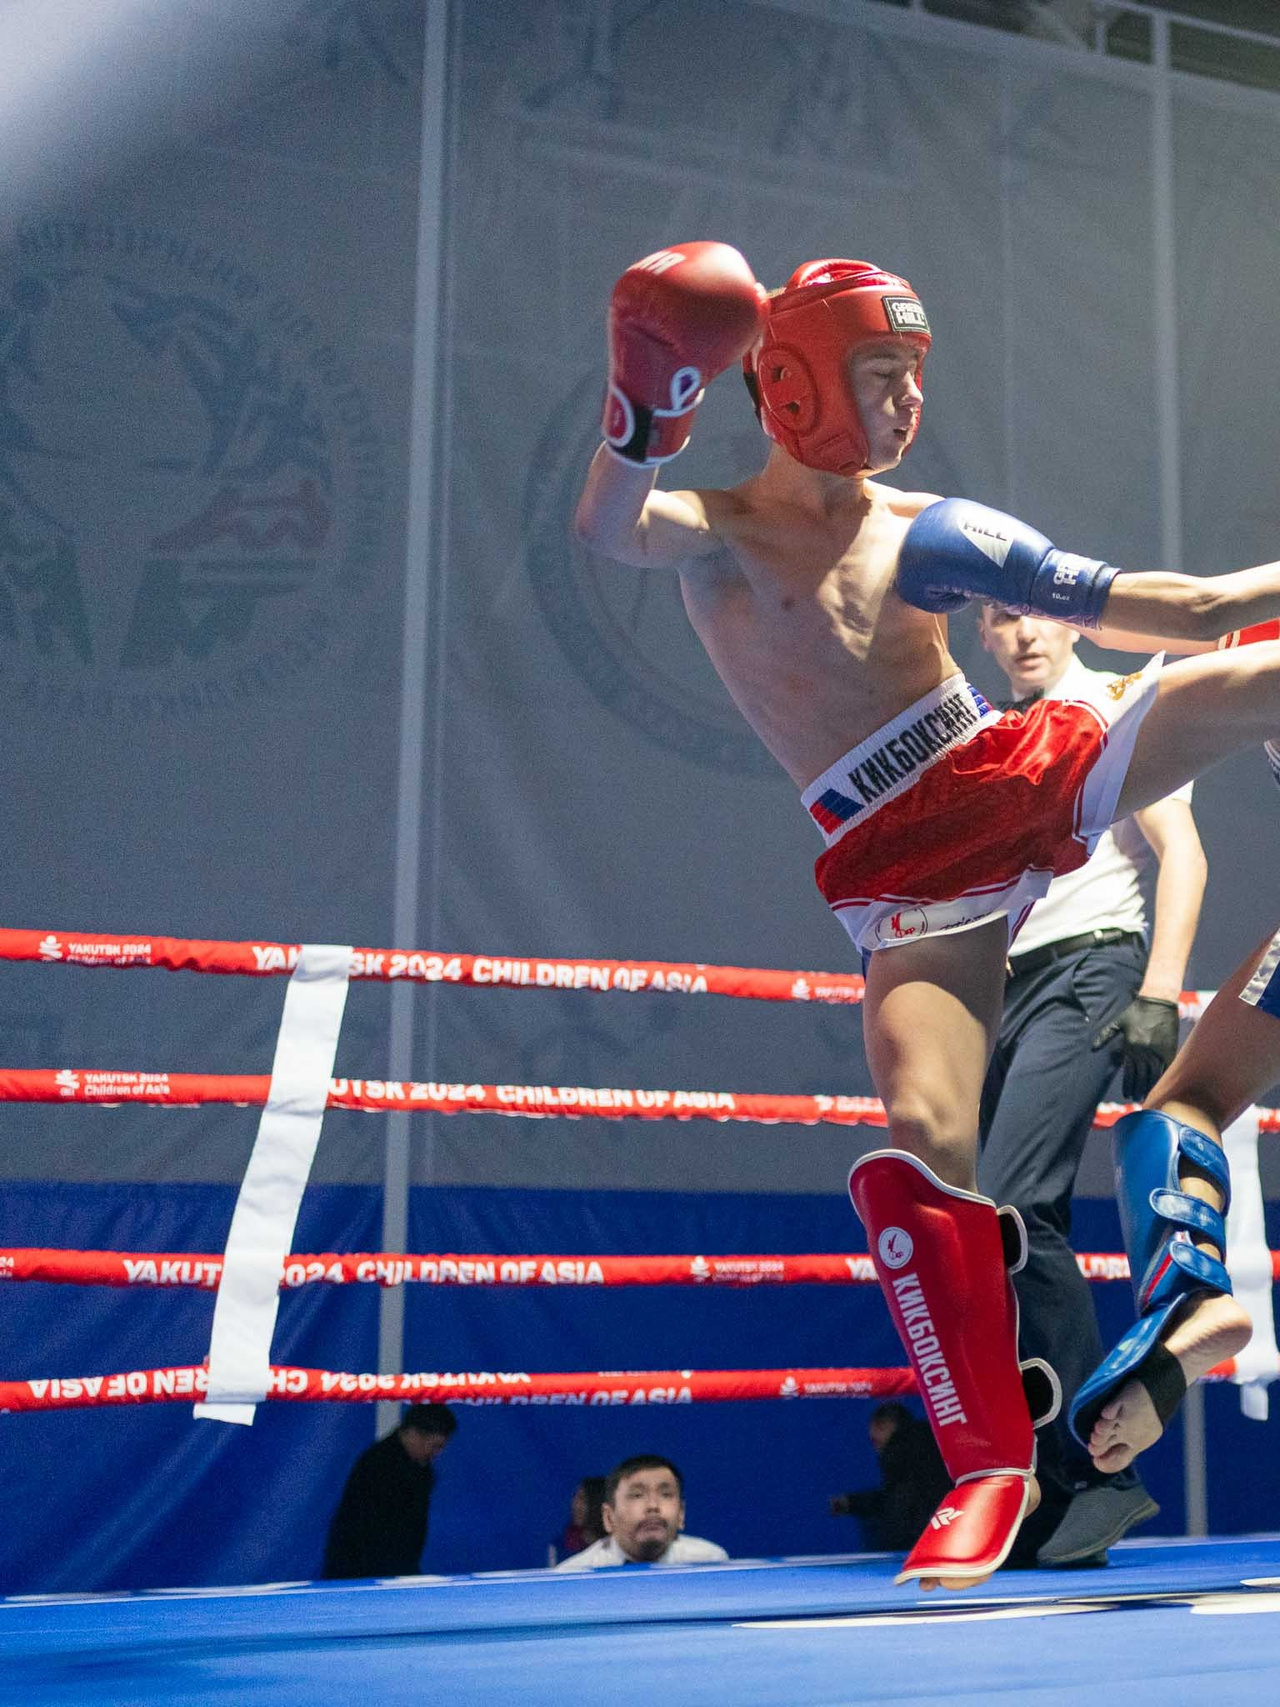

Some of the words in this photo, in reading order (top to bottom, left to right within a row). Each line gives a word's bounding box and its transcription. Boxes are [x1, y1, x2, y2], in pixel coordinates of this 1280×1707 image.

[390, 955, 462, 982] 2024
[472, 957, 611, 990] CHILDREN
[613, 967, 648, 992] OF
[357, 1259, 495, 1287] CHILDREN
[500, 1261, 538, 1283] OF
[540, 1260, 605, 1285] ASIA
[891, 1272, 968, 1428] КИКБОКСИНГ
[27, 1376, 105, 1399] ASIA
[107, 1370, 148, 1397] OF
